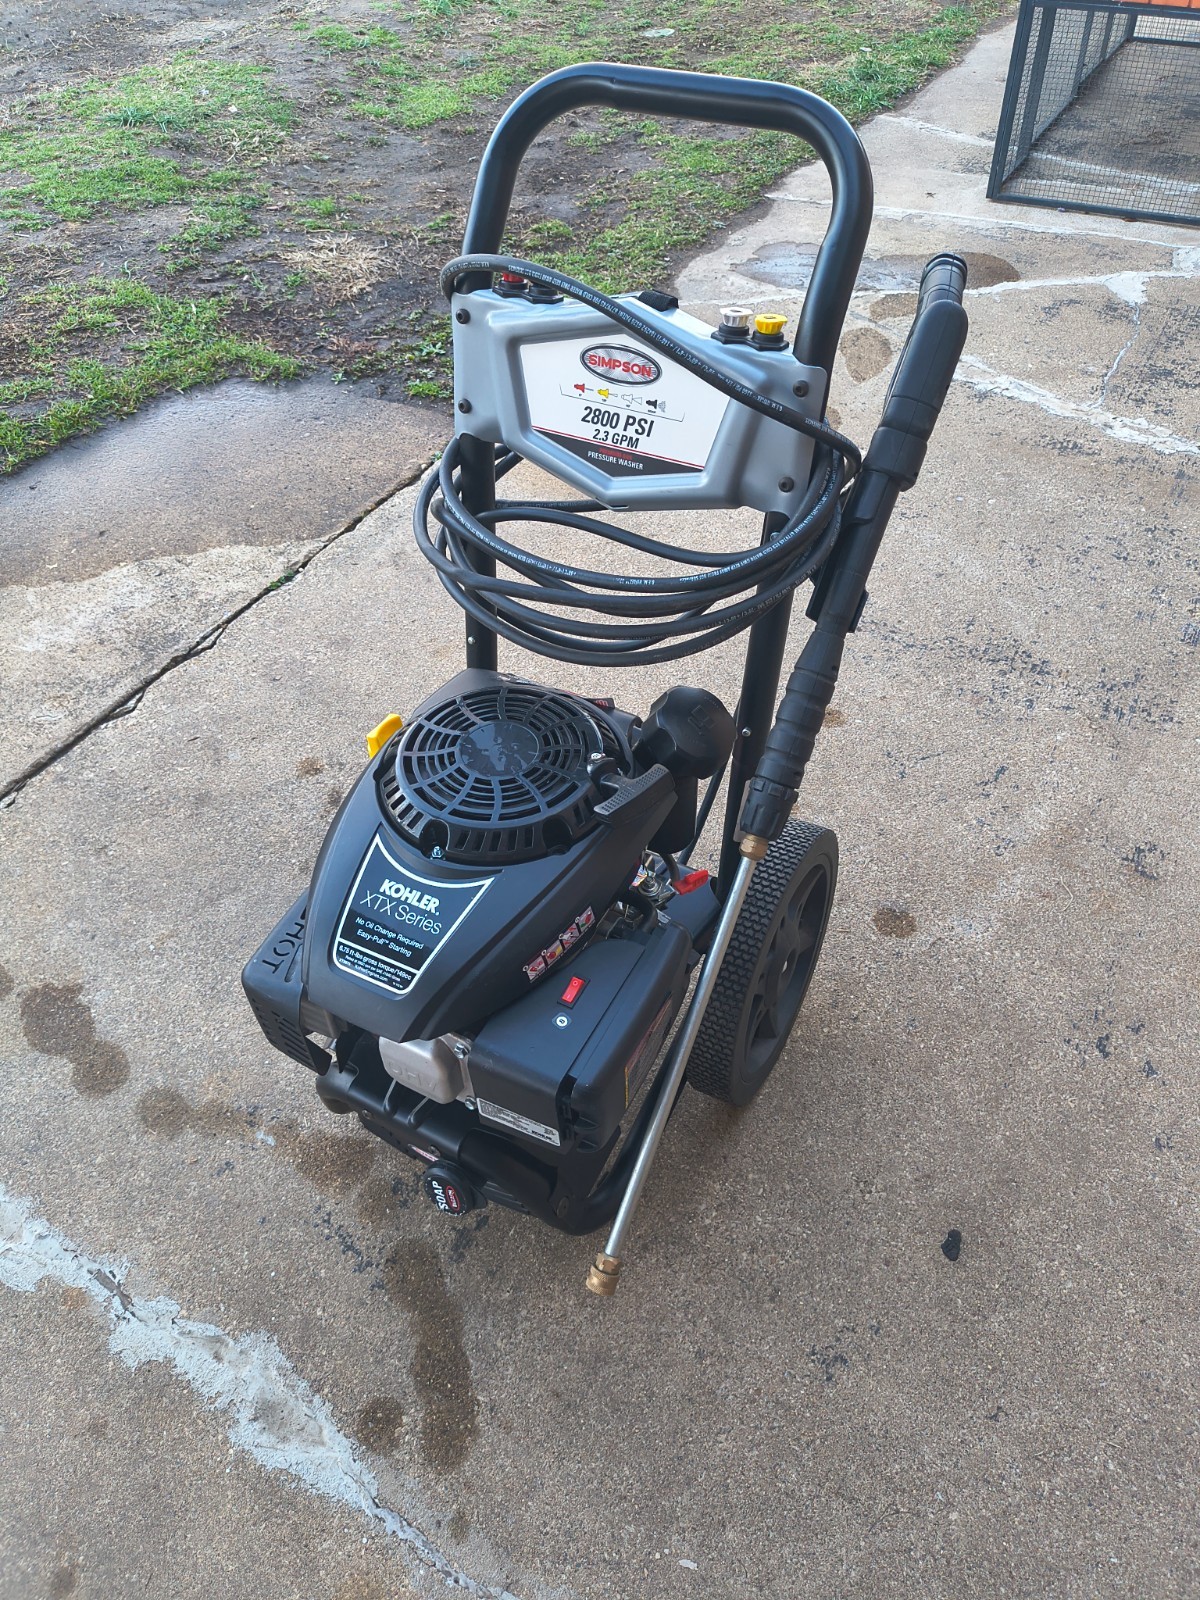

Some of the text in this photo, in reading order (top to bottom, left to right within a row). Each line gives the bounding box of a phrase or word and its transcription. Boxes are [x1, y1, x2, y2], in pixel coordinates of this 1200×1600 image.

[587, 354, 654, 378] SIMPSON
[580, 405, 654, 438] 2800 PSI
[592, 428, 640, 450] 2.3 GPM
[587, 450, 618, 465] PRESSURE
[618, 456, 644, 470] WASHER
[360, 890, 442, 934] XTX Series
[355, 916, 424, 950] No Oil Change Required
[262, 922, 304, 974] HOT
[362, 954, 378, 968] gross
[389, 942, 412, 958] Starting
[432, 1180, 449, 1210] SOAP
